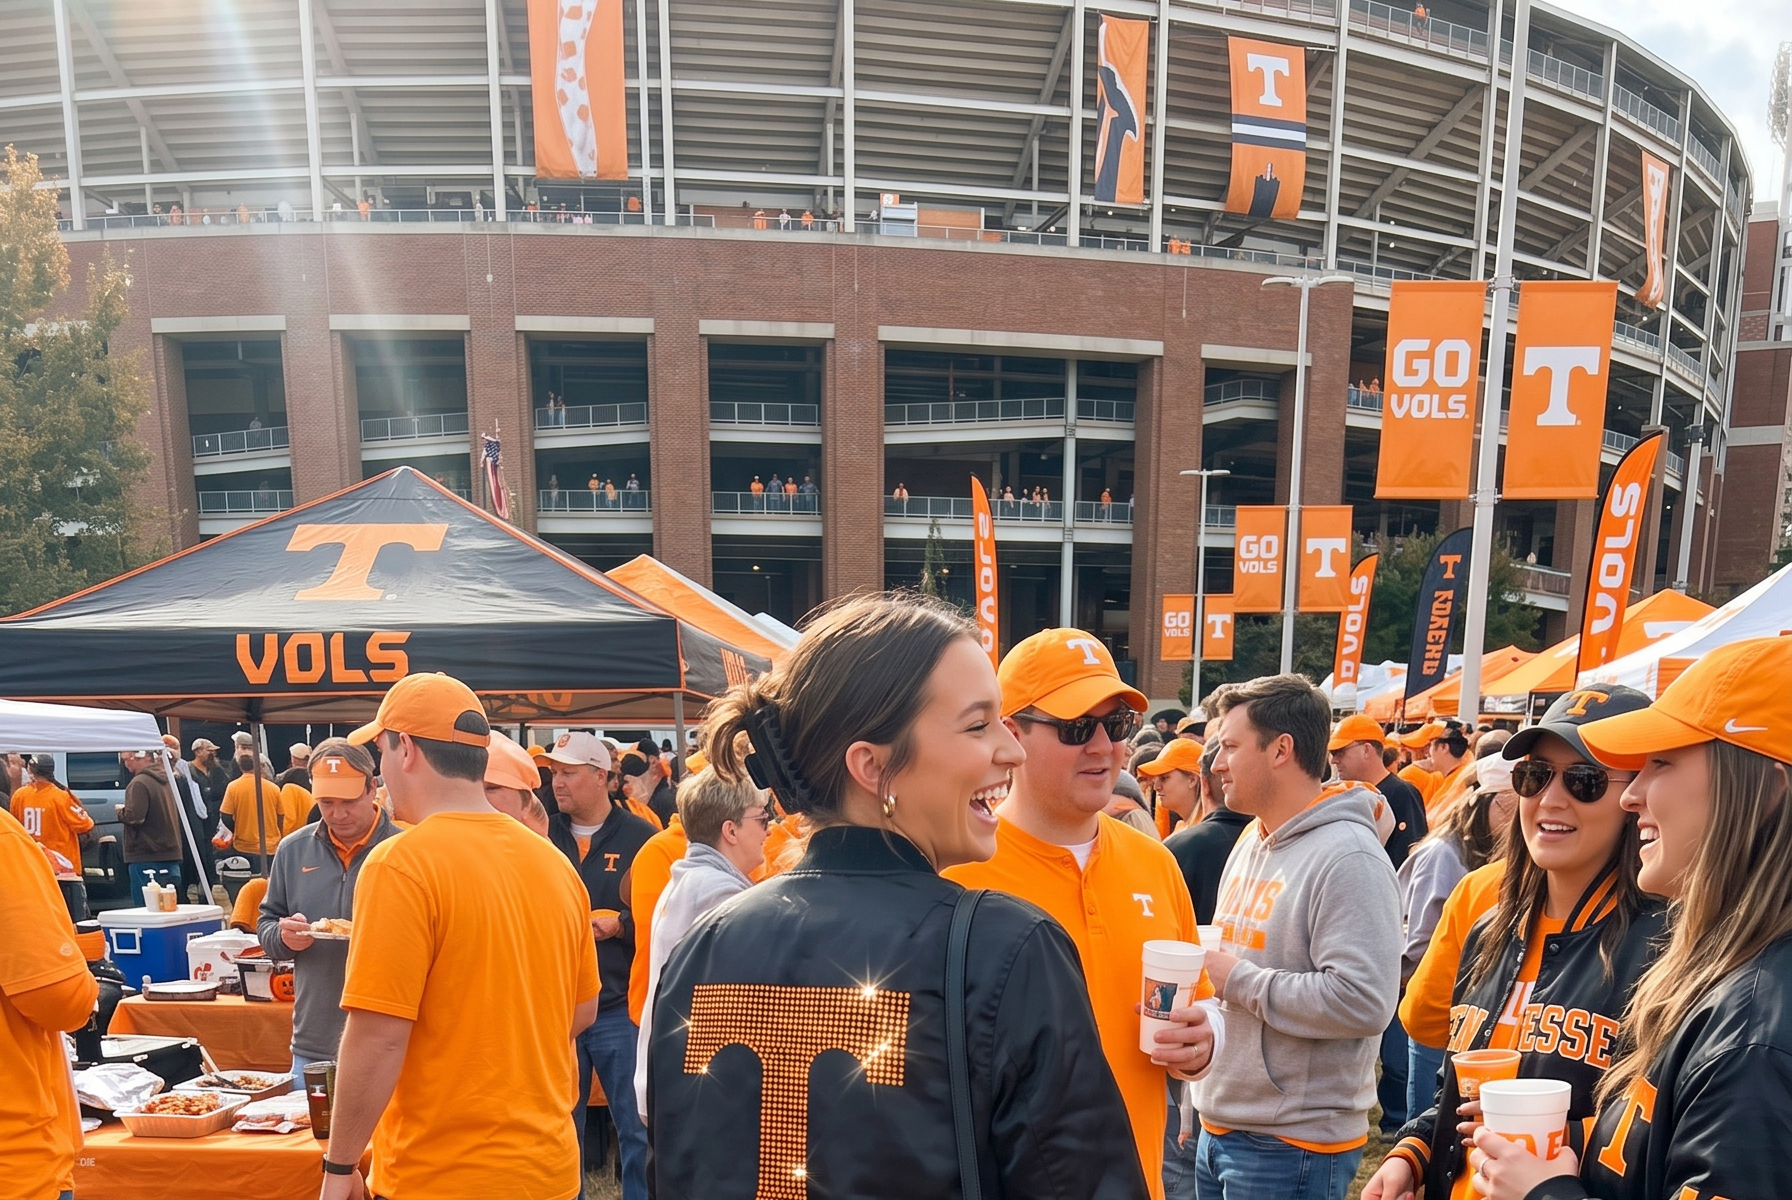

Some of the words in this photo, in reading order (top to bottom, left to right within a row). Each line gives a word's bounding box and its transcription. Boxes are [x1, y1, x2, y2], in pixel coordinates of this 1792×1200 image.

[1247, 53, 1290, 107] T
[1393, 339, 1471, 387] GO
[1523, 347, 1600, 425] T
[1391, 394, 1467, 418] VOLS
[1240, 535, 1279, 559] GO
[1306, 538, 1347, 578] T
[1591, 482, 1641, 635] VOLS
[286, 524, 449, 600] T
[1239, 561, 1278, 573] VOLS
[1440, 555, 1462, 578] T
[1164, 612, 1190, 627] GO
[1207, 614, 1231, 638] T
[1342, 575, 1369, 655] VOLS
[1164, 629, 1190, 637] VOLS
[236, 632, 412, 684] VOLS
[1066, 638, 1101, 665] T
[1566, 690, 1609, 716] T
[327, 760, 341, 773] T
[1132, 893, 1154, 917] T
